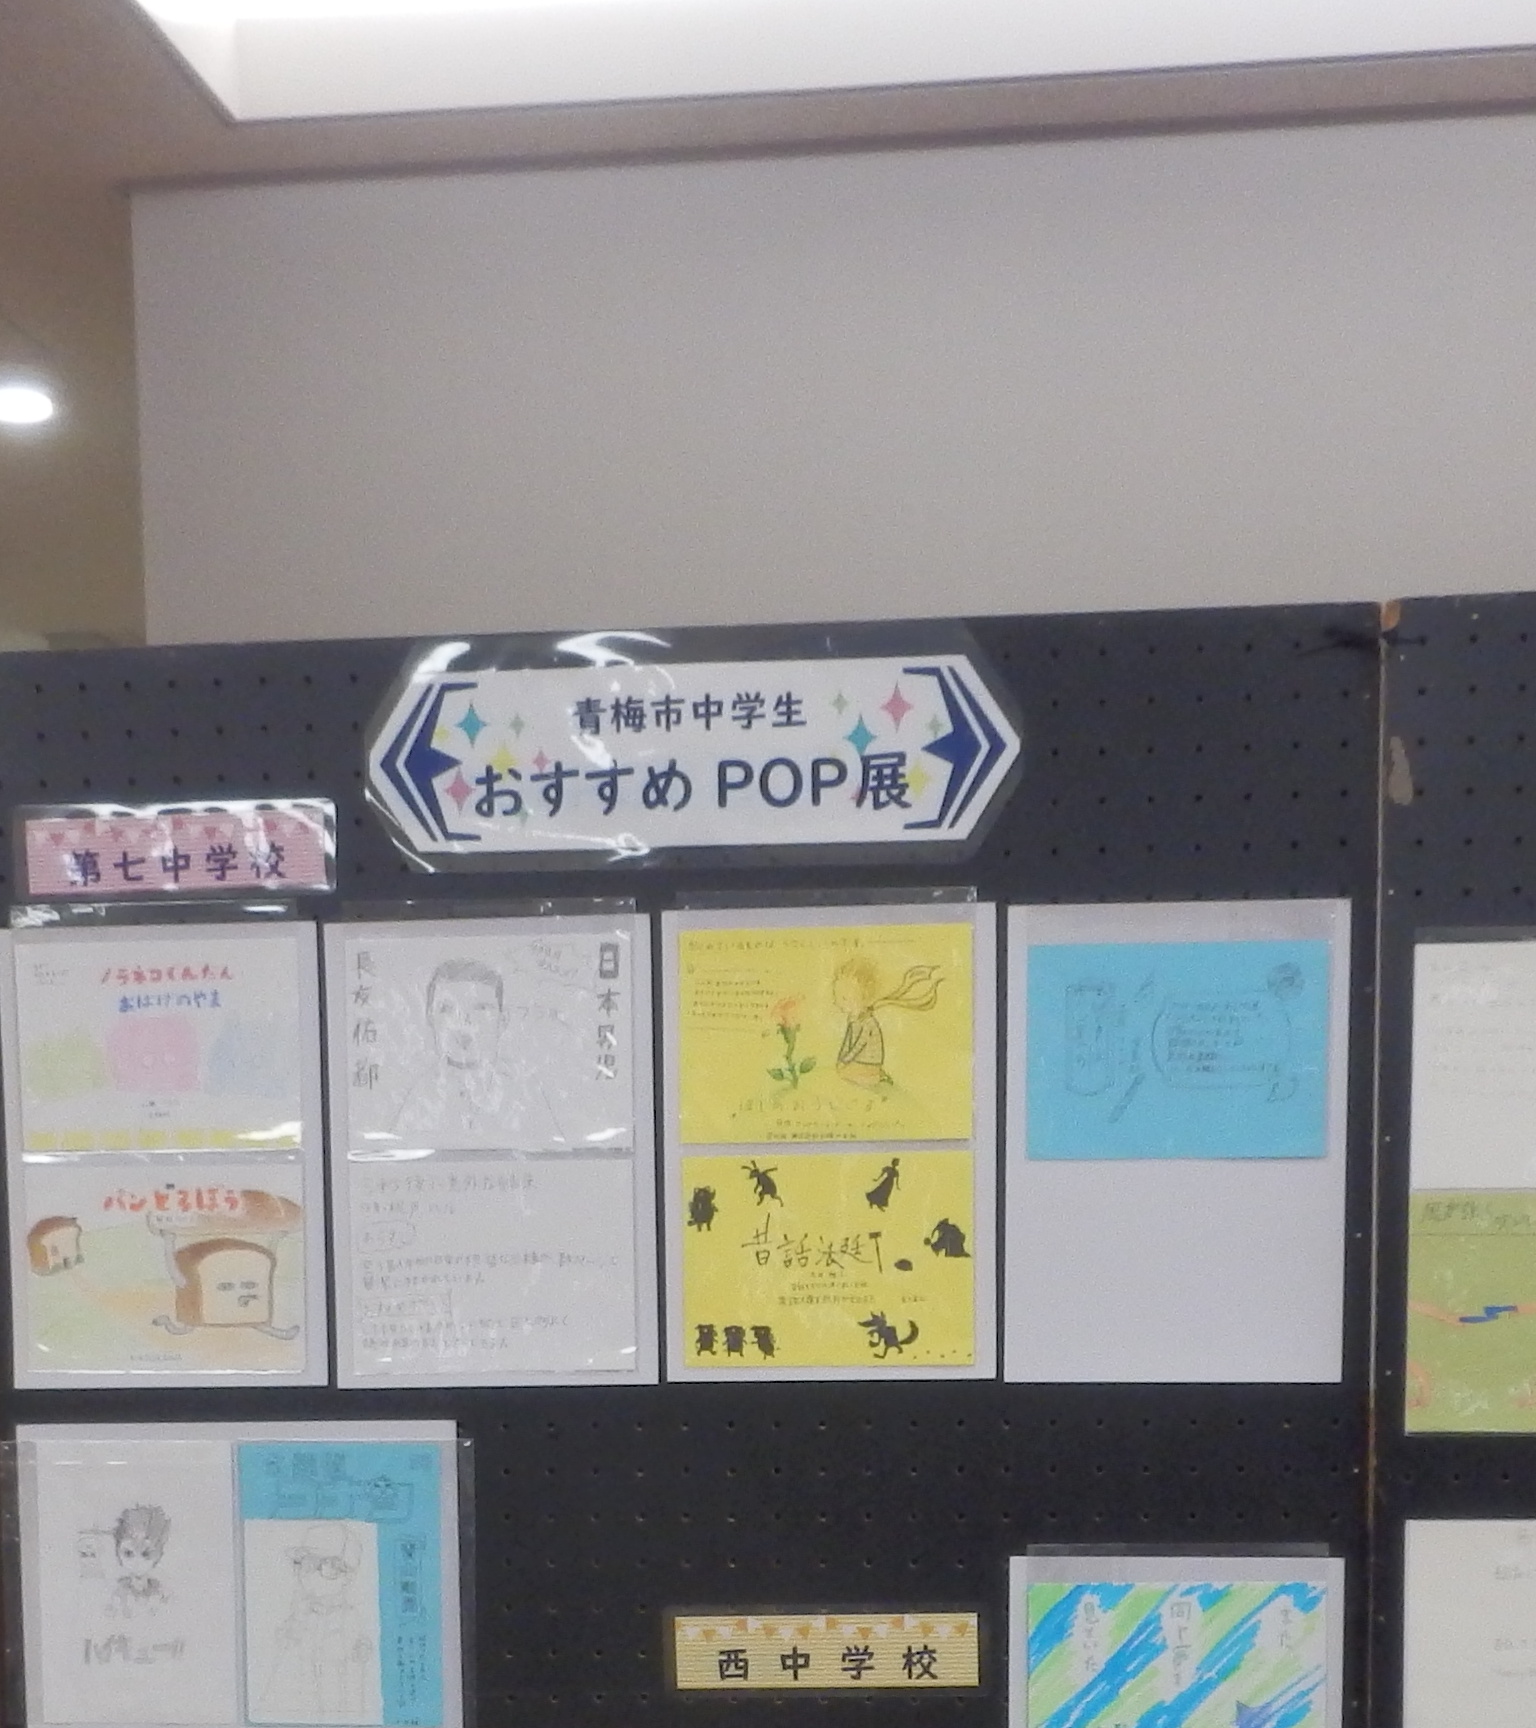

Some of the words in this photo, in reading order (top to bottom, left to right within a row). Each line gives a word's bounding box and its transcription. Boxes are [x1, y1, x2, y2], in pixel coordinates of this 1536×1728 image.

[572, 693, 809, 736] 青梅市中学生
[68, 841, 290, 884] 第七中学校
[716, 1644, 940, 1682] 西中学校
